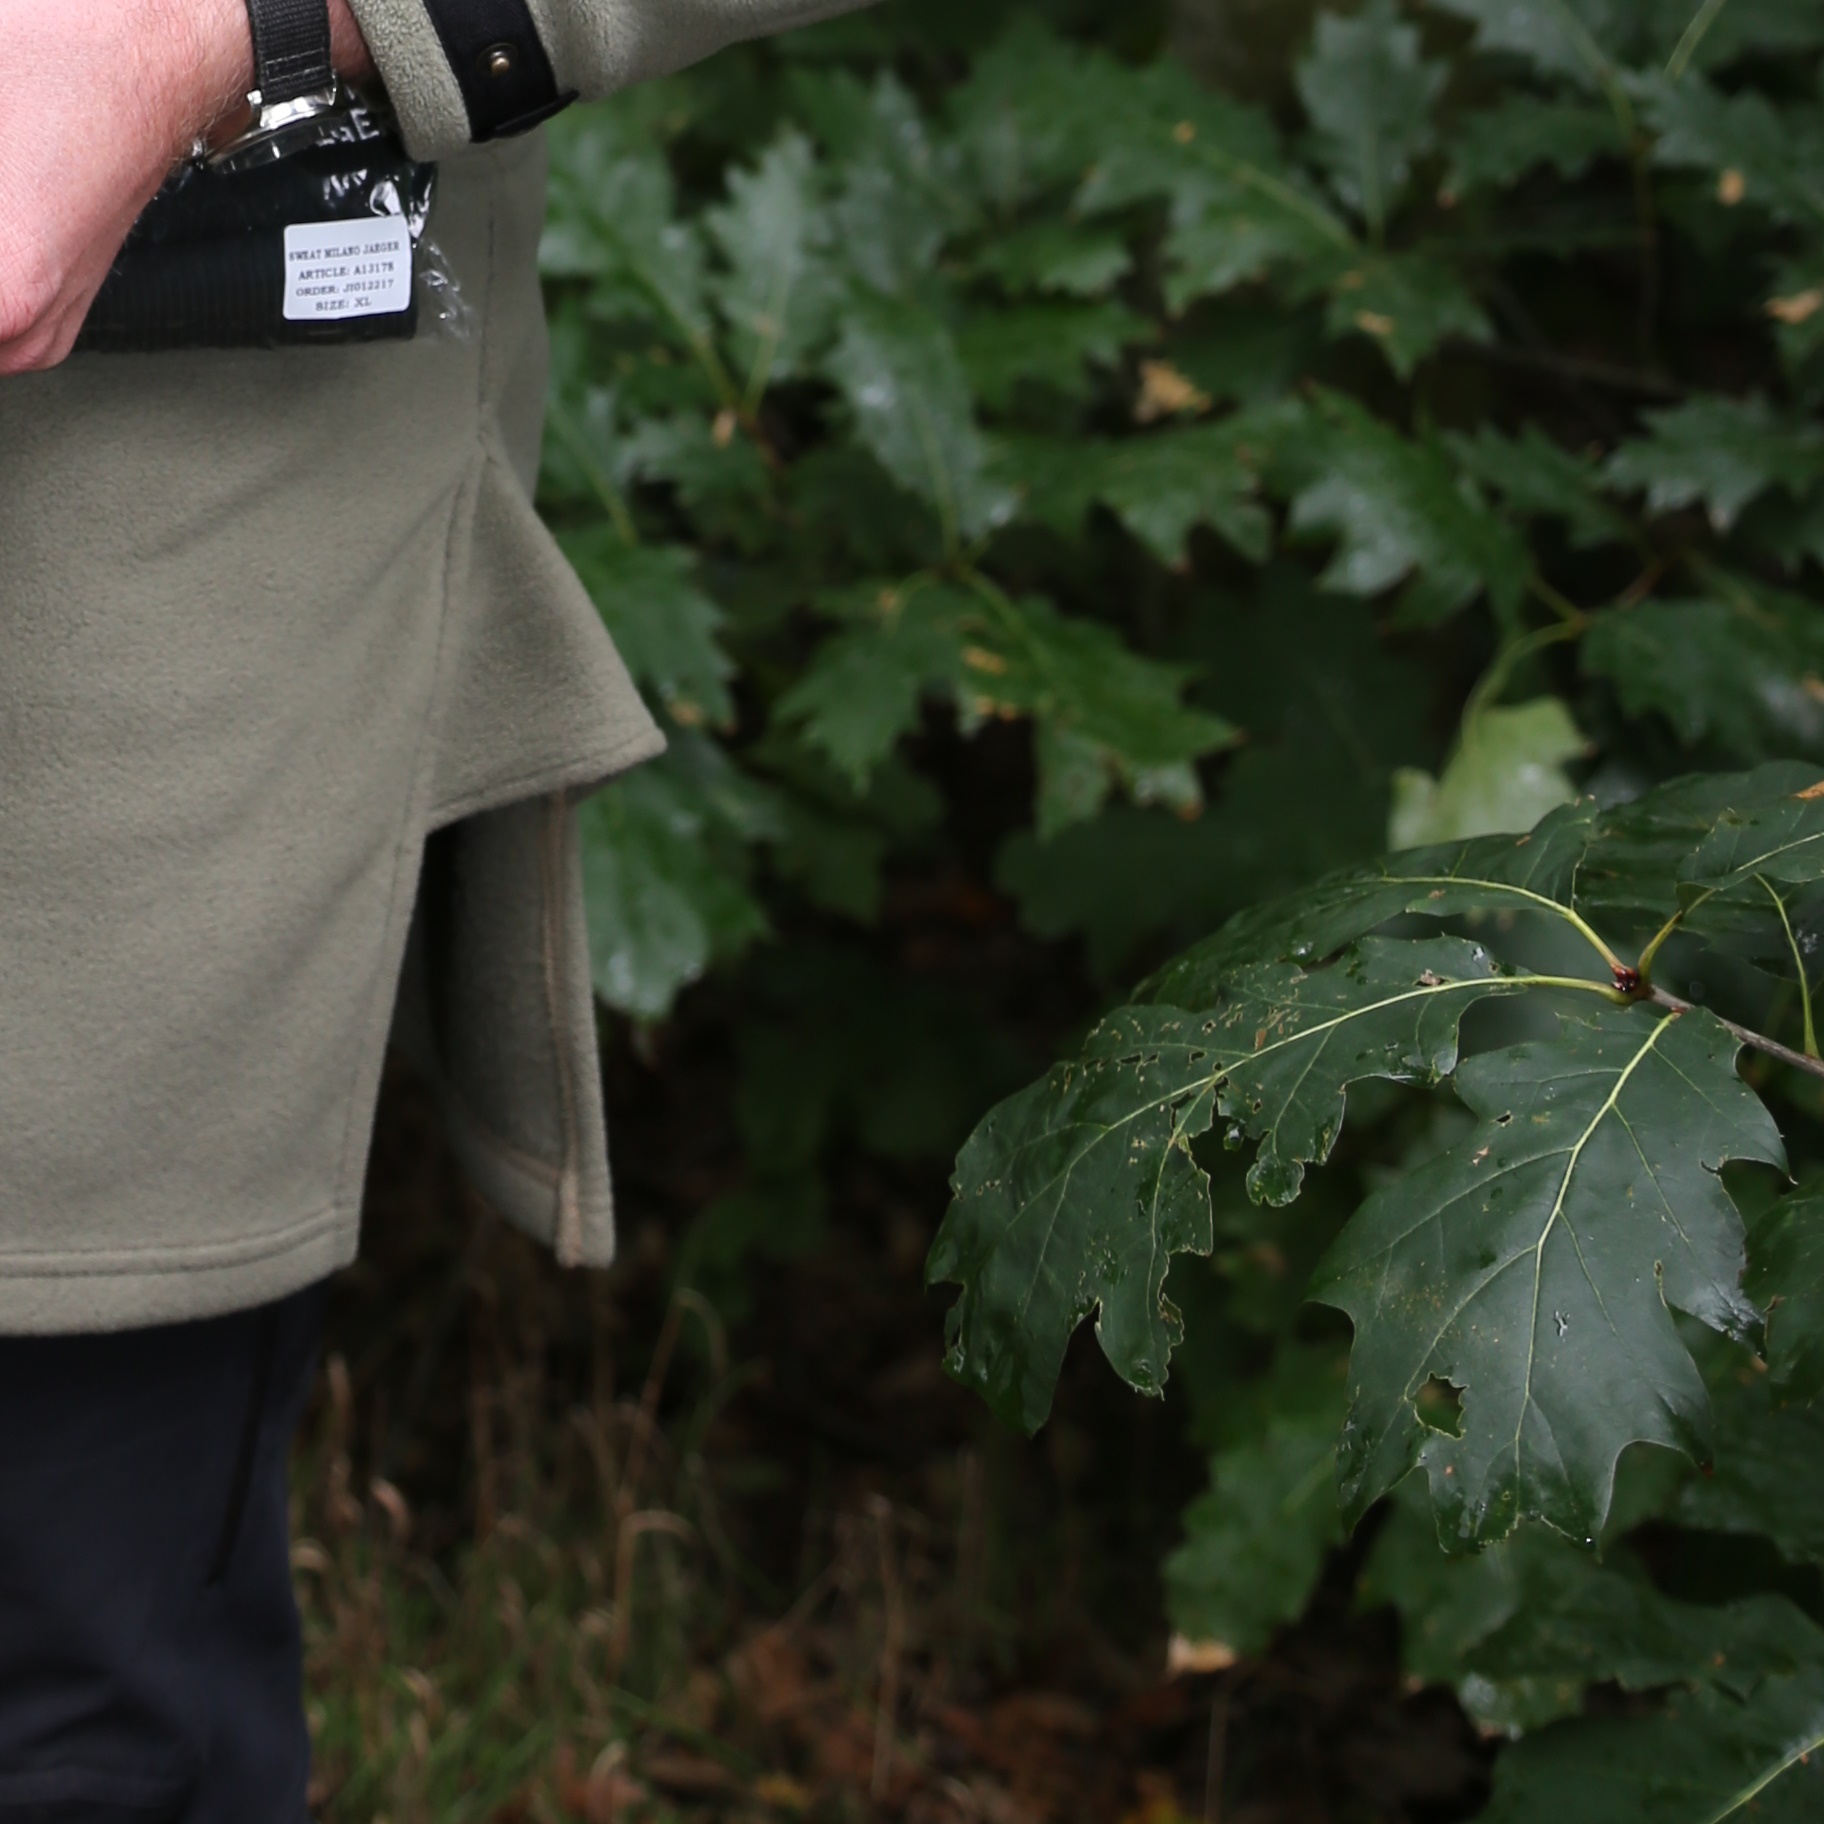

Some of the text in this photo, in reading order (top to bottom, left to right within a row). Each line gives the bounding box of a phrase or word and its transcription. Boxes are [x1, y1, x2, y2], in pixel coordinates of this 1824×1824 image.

[288, 241, 400, 262] SWEAT MILANO JAEGER
[298, 262, 395, 281] ARTICLE: A13178
[295, 285, 340, 297] ORDER:
[315, 297, 372, 312] SIZE: XL
